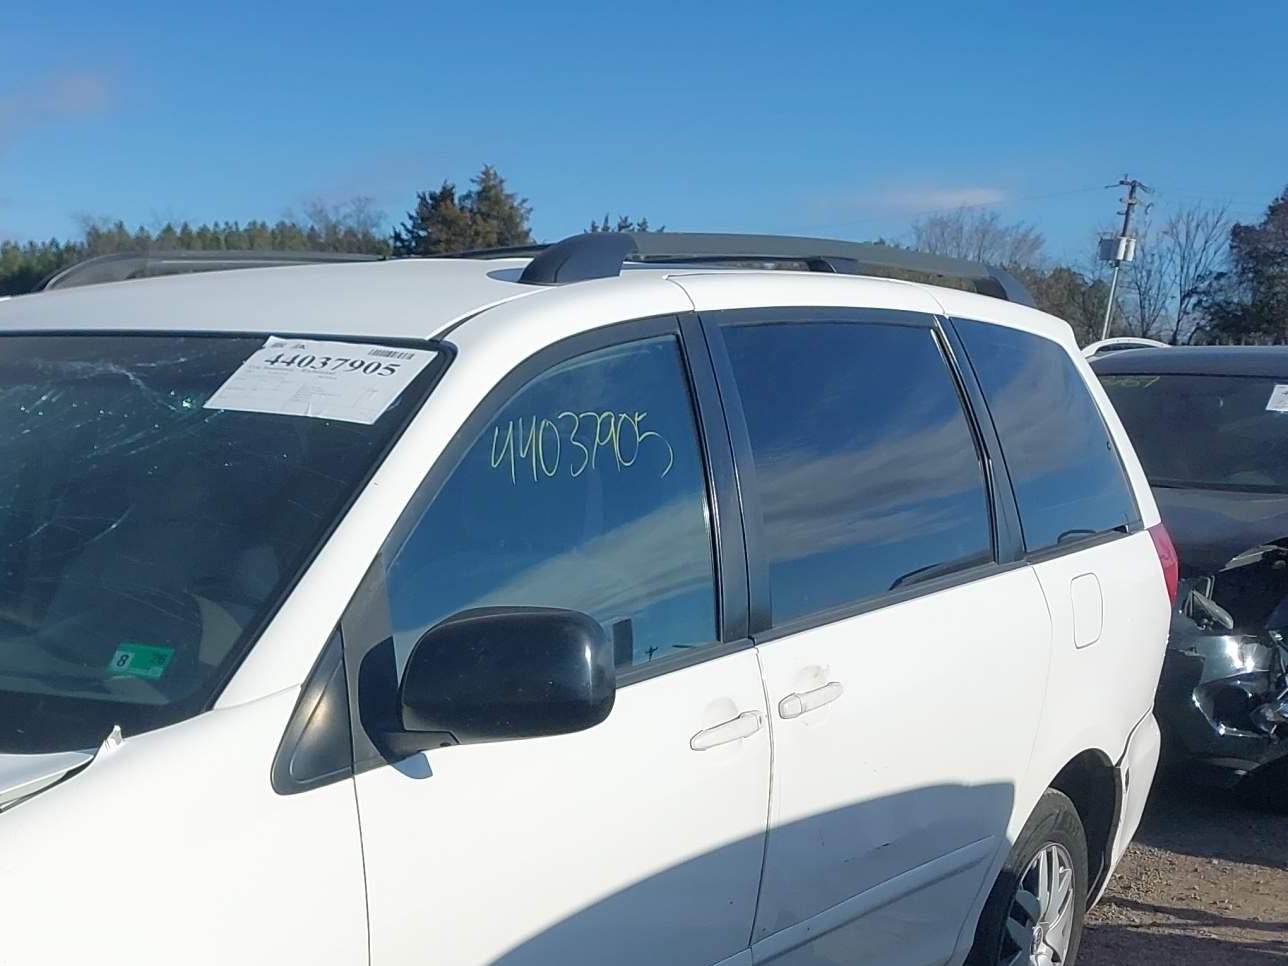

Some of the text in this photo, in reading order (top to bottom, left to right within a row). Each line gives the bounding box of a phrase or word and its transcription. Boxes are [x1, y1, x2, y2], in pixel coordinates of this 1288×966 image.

[265, 352, 401, 377] 44037905
[491, 411, 674, 485] 44037905
[116, 654, 130, 667] 8
